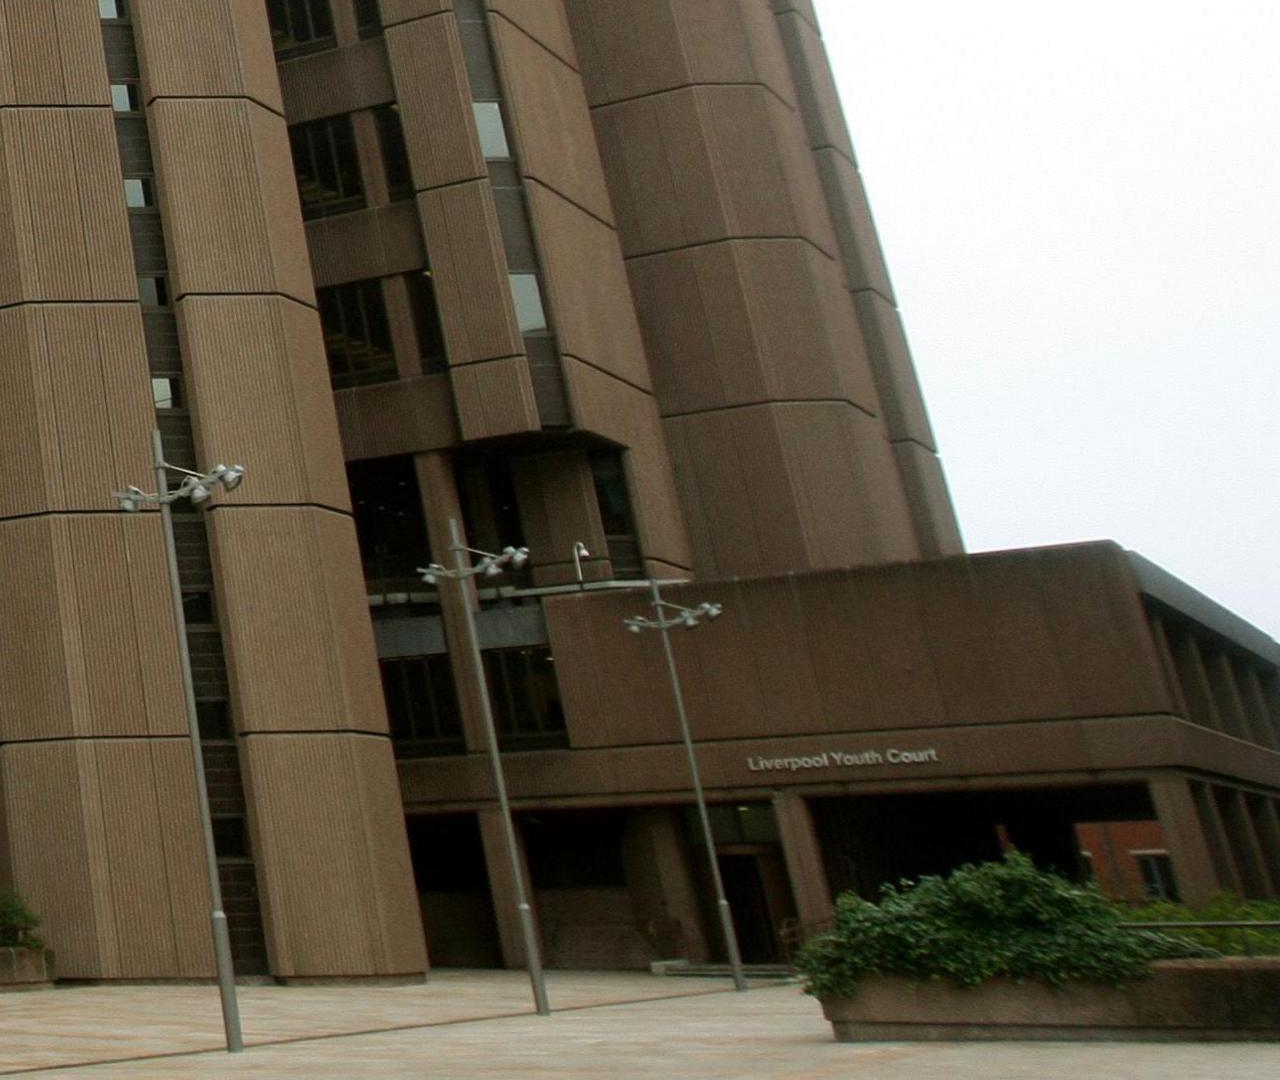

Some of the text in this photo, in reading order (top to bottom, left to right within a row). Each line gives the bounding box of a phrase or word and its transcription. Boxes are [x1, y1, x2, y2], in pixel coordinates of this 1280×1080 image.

[747, 748, 938, 771] Liverpool Youth Court
